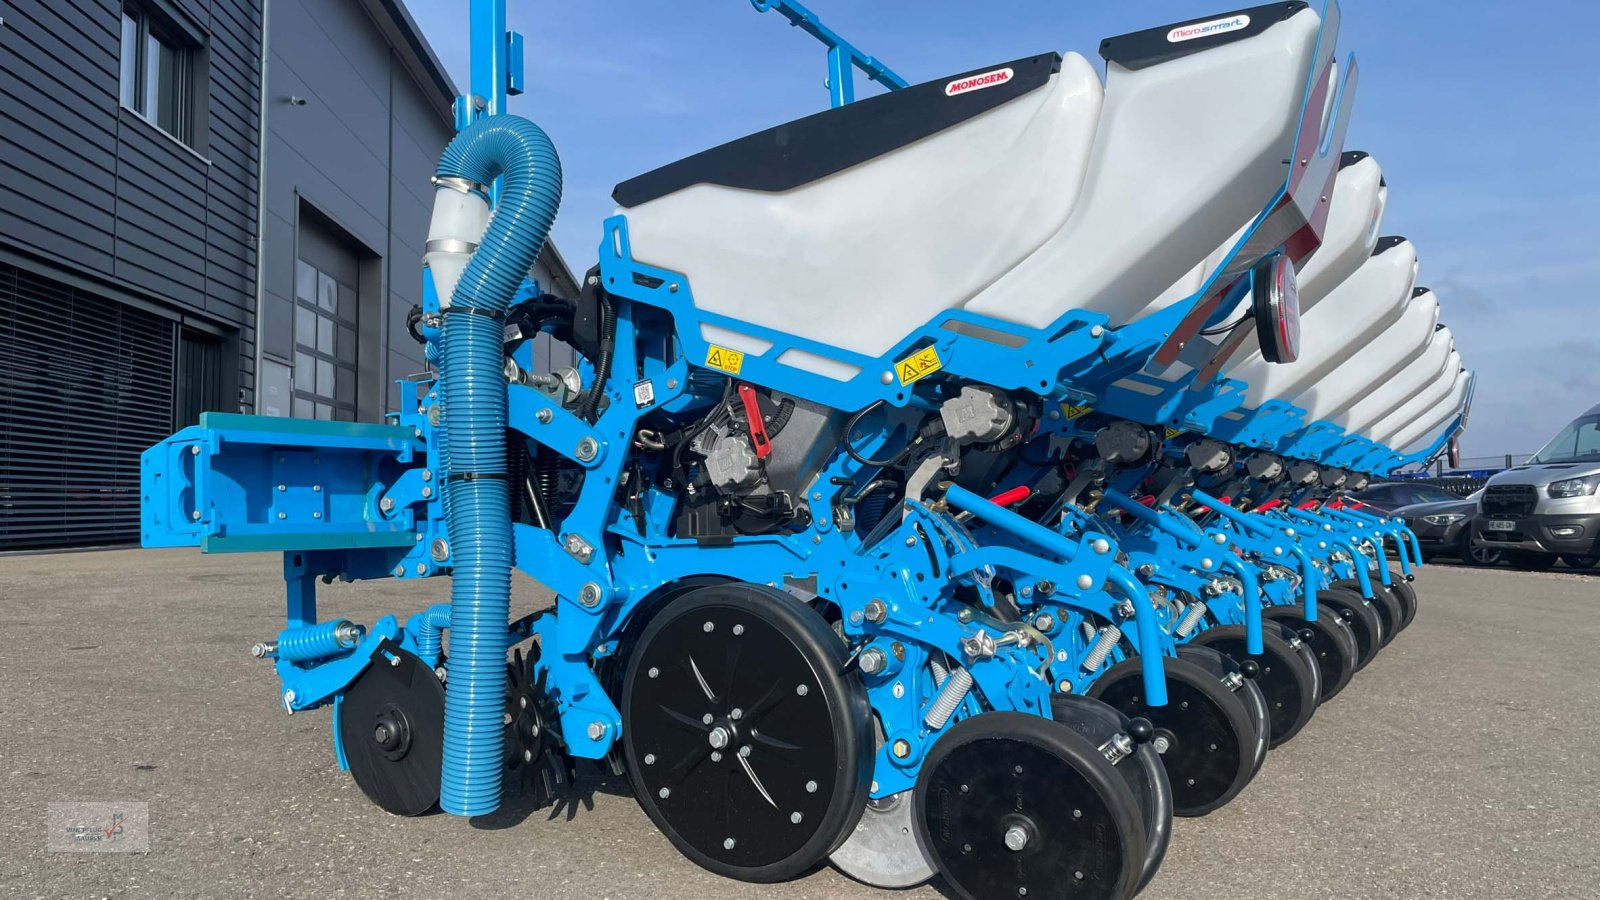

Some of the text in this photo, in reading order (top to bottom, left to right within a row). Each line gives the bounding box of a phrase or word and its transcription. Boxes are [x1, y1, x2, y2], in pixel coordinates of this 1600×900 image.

[1173, 18, 1243, 38] Microsmart
[949, 71, 1008, 94] MONOSEM
[724, 364, 738, 372] STOP
